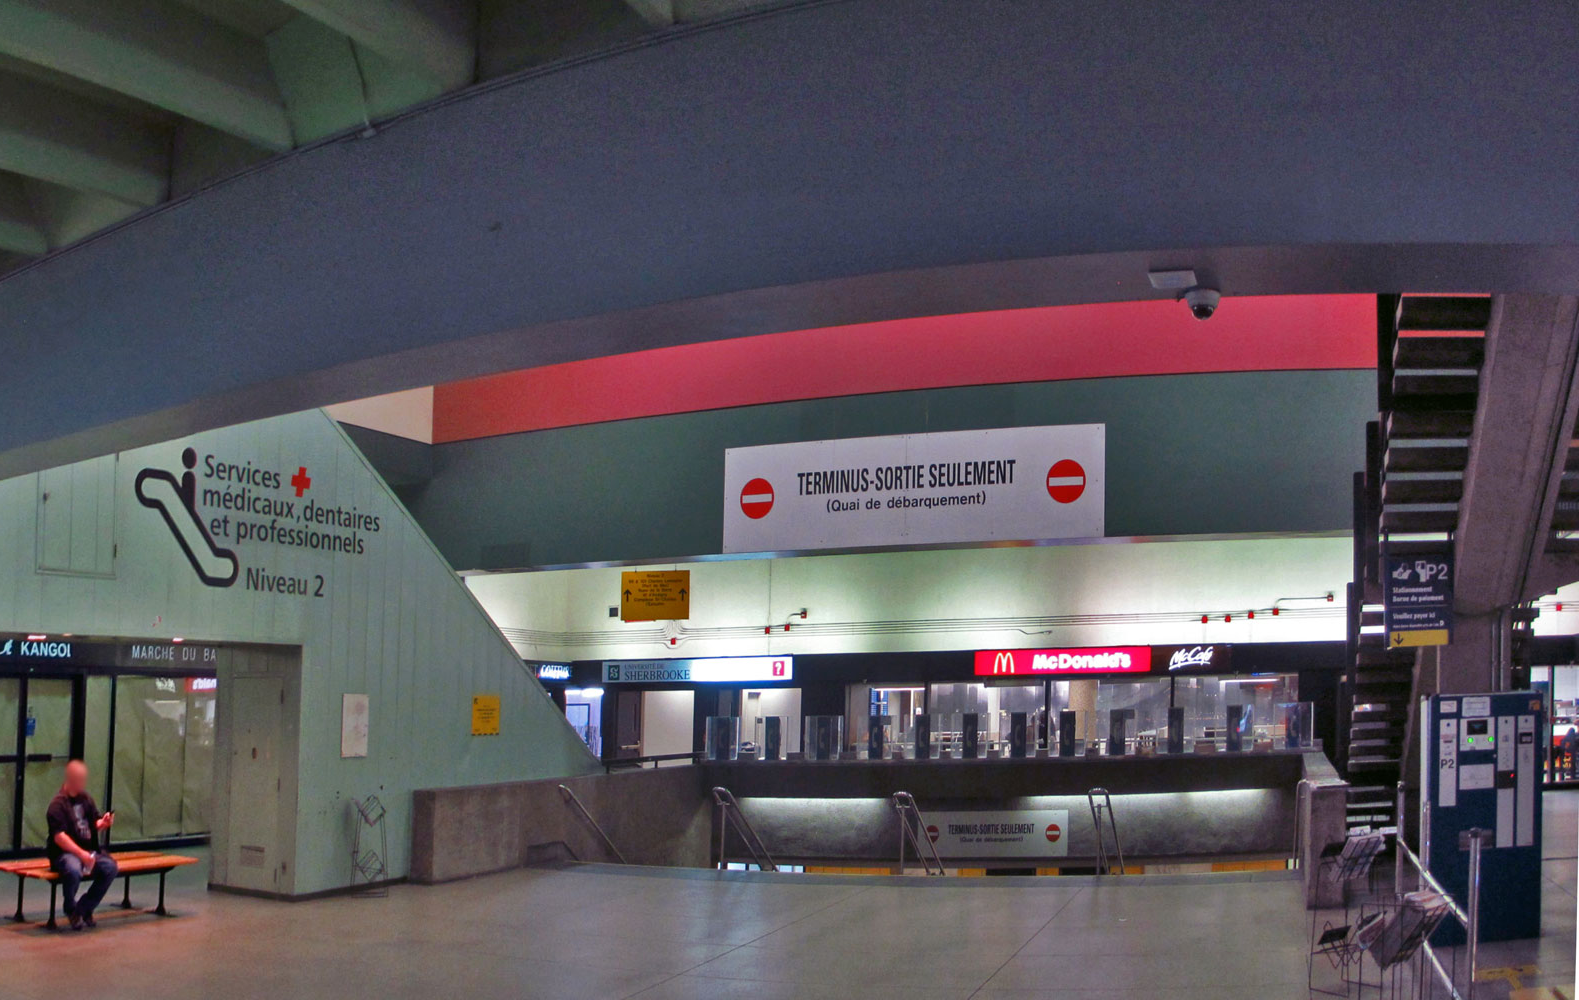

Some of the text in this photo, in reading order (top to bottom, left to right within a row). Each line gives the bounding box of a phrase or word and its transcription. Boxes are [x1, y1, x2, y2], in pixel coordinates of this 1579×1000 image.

[204, 454, 281, 490] Services
[797, 459, 1016, 496] TERMINUS-SORTIE SEULEMENT
[826, 490, 987, 513] (Quai de débarquement)
[210, 515, 365, 555] et professionnels
[1425, 563, 1448, 580] P2
[245, 567, 325, 598] Niveau 2
[182, 646, 197, 661] DU
[1032, 652, 1132, 670] McDonald's
[624, 669, 691, 680] SHERBROOKE
[1440, 759, 1454, 769] P2
[948, 823, 1034, 835] TERMINUS-SORTIE SEULEMENT
